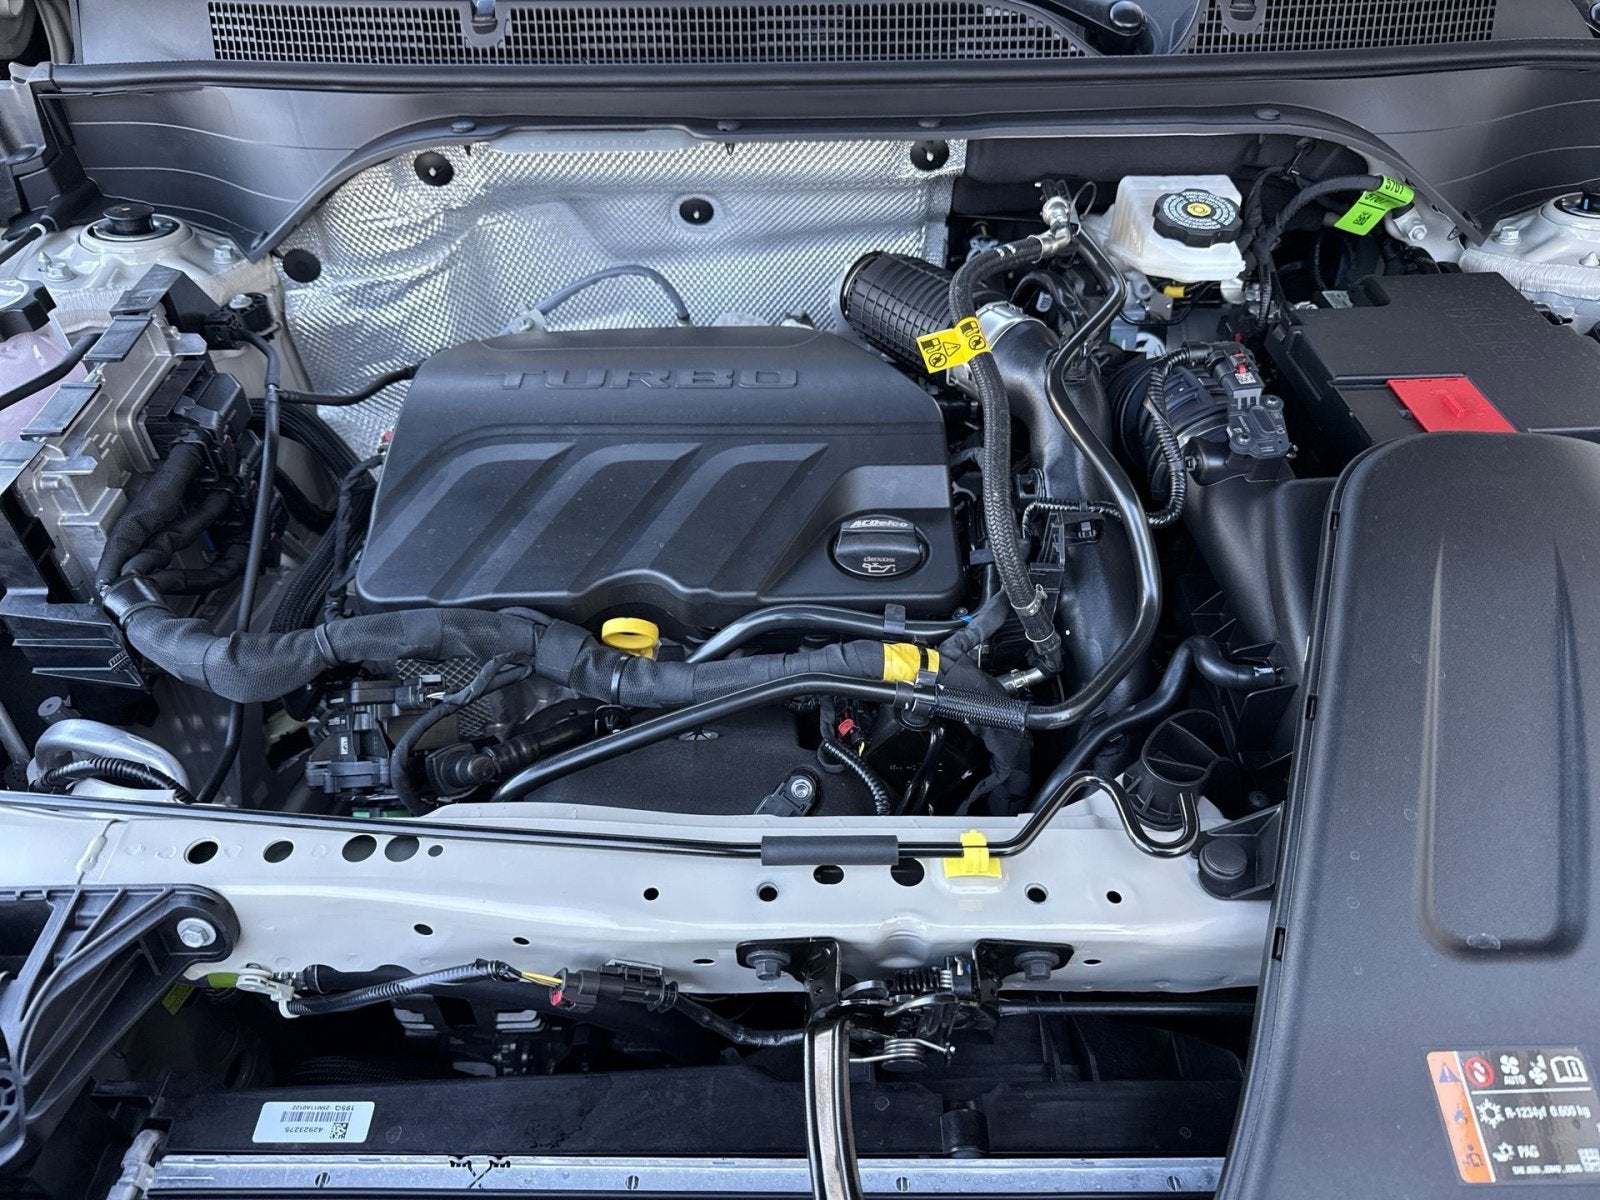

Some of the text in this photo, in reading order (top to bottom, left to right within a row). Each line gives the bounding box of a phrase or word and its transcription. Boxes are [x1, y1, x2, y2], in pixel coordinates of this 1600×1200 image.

[485, 369, 799, 390] TURBO
[850, 519, 909, 529] ACDelco
[1503, 1075, 1527, 1086] AUTO
[1517, 1145, 1540, 1158] PAG
